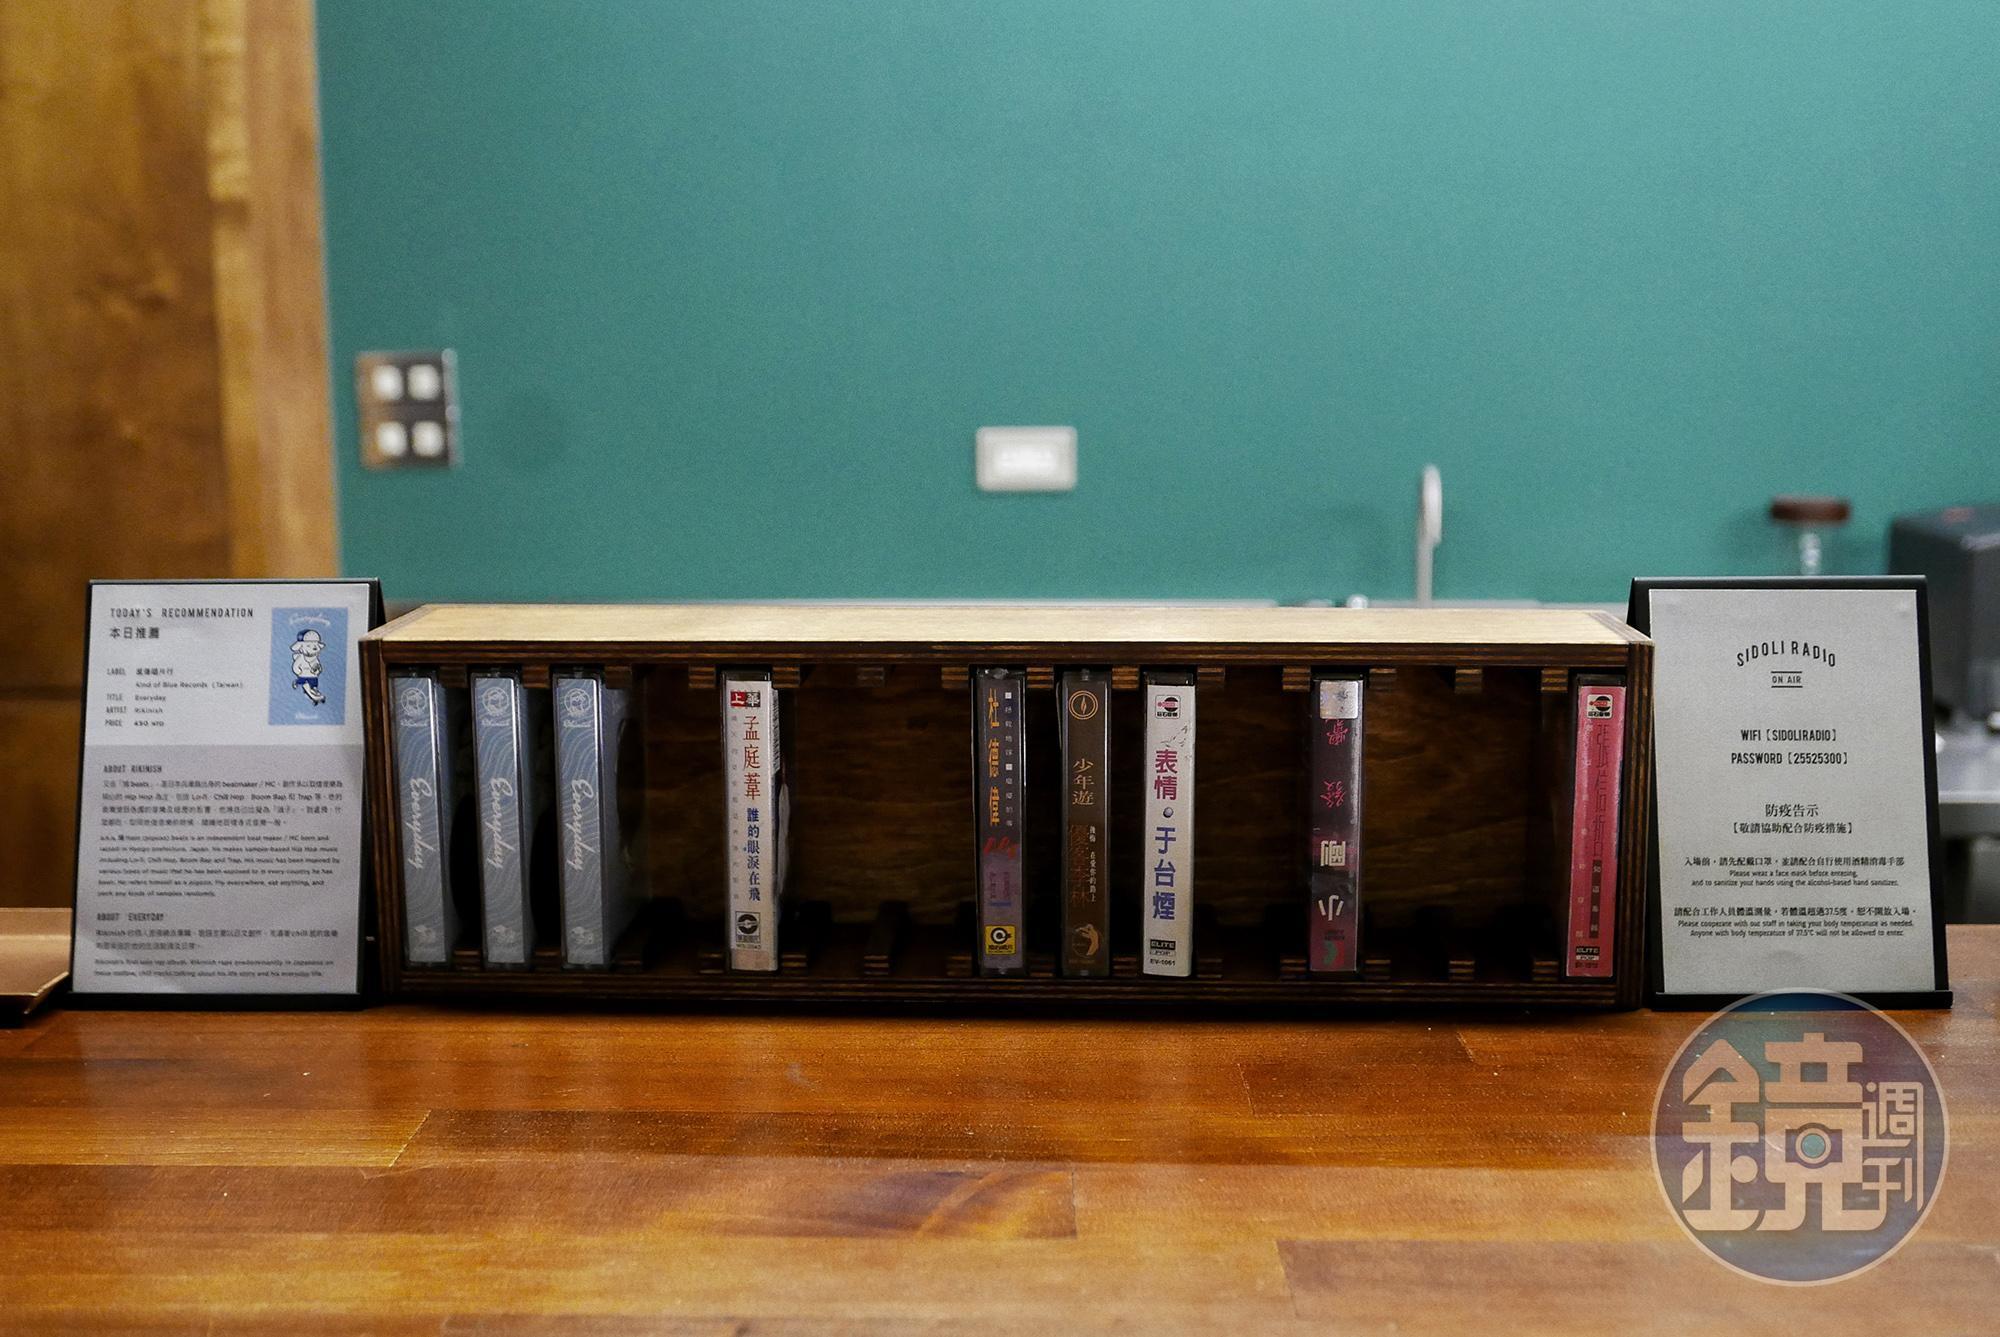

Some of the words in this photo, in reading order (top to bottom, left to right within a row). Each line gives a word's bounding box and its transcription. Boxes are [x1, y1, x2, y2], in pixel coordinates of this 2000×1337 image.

[110, 608, 152, 618] TODAY'S
[161, 608, 254, 618] RECOMMENDATION
[1736, 641, 1784, 666] SIDOLI
[1791, 641, 1836, 667] RADIO
[1771, 676, 1783, 684] ON
[1787, 675, 1802, 684] AIR
[1740, 729, 1761, 741] WIFI
[743, 715, 761, 801] 孟庭葦
[1731, 752, 1783, 764] PASSWORD
[1071, 757, 1095, 806] 少年遊
[1154, 749, 1179, 800] 表情
[1765, 804, 1819, 818] 防疫告示
[746, 807, 761, 902] 誰的眼淚在飛
[1152, 826, 1177, 920] 于台煙
